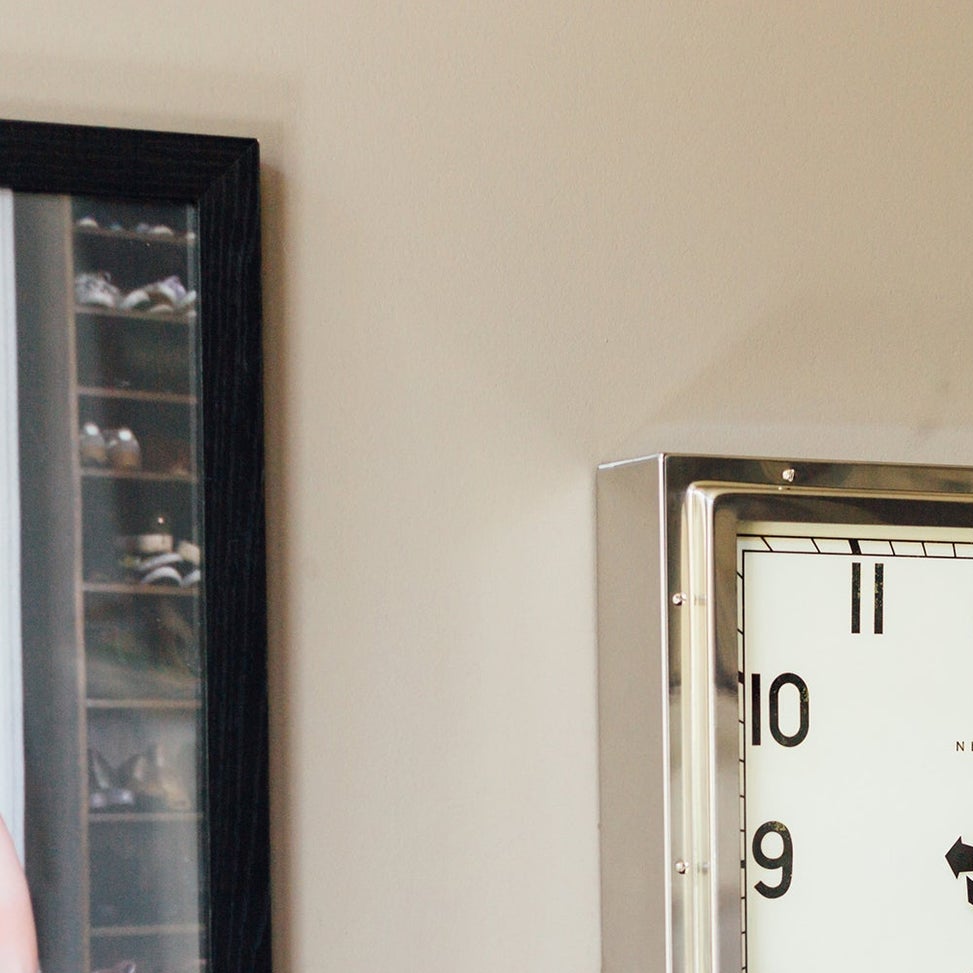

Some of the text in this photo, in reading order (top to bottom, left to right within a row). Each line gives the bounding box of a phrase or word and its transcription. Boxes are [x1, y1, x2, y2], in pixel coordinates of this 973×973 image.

[851, 562, 884, 635] 11
[751, 672, 810, 748] 10
[751, 820, 794, 899] 9
